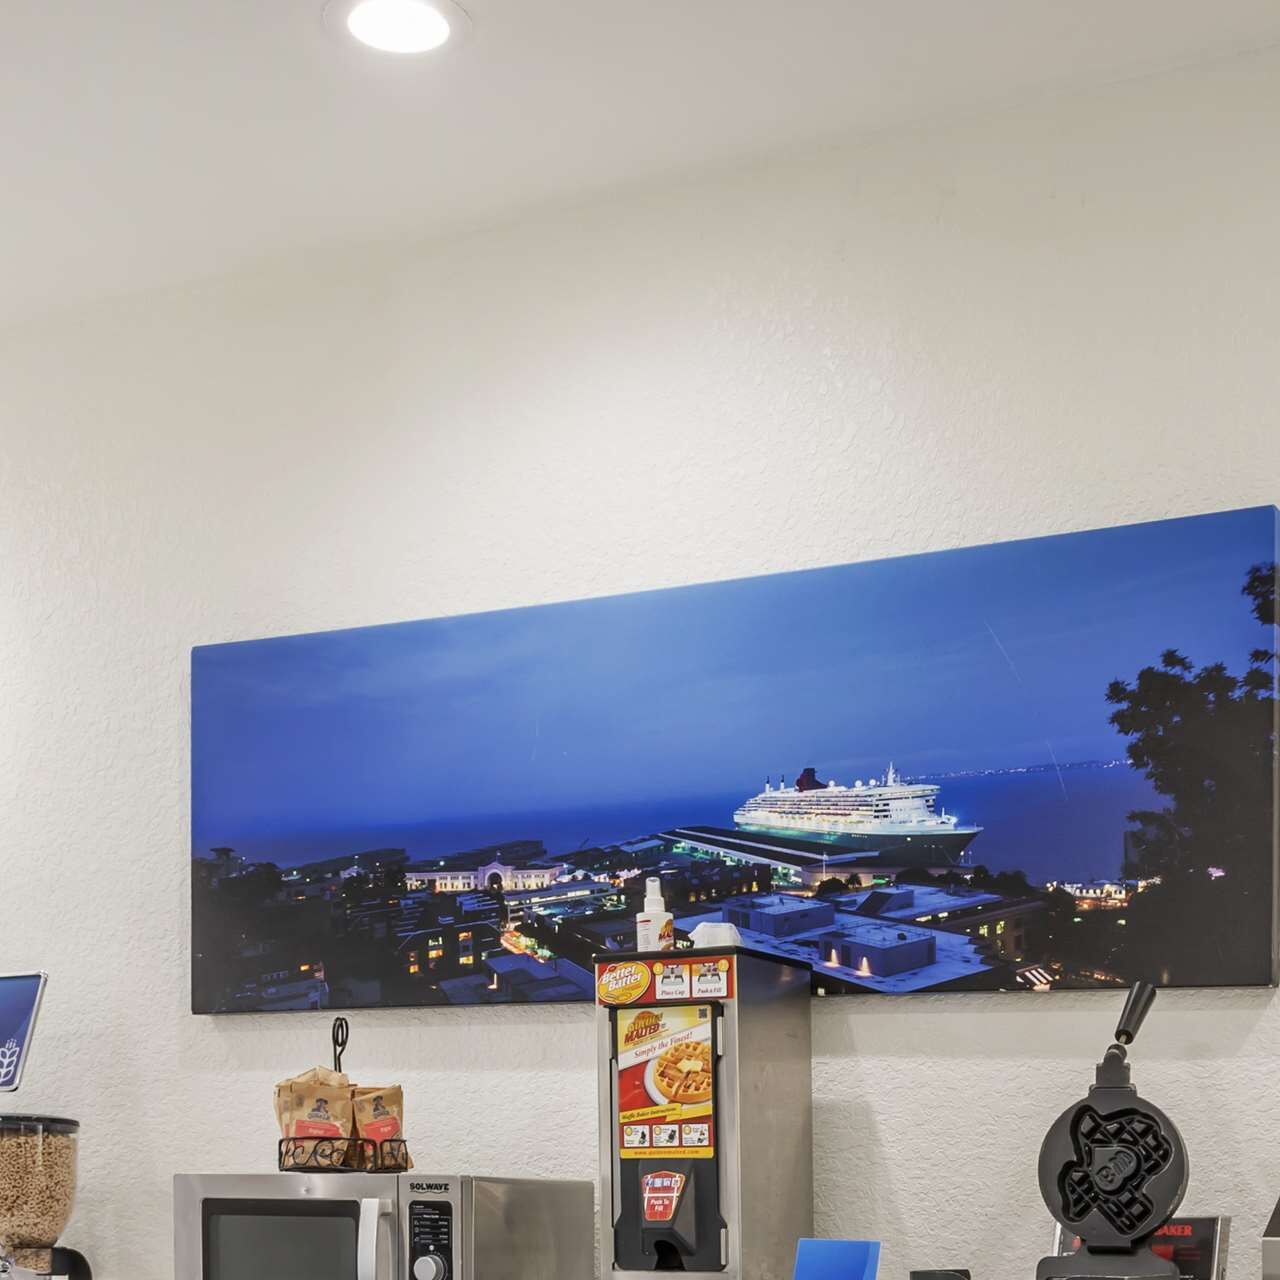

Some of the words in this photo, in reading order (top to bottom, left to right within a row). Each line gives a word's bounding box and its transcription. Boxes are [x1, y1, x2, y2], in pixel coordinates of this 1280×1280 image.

[602, 966, 636, 984] Better
[608, 973, 642, 991] Batter
[624, 1023, 660, 1043] MALTED
[634, 1046, 657, 1058] Simply
[657, 1040, 669, 1049] the
[670, 1031, 693, 1046] Finest!
[410, 1183, 449, 1191] SOLWAVE
